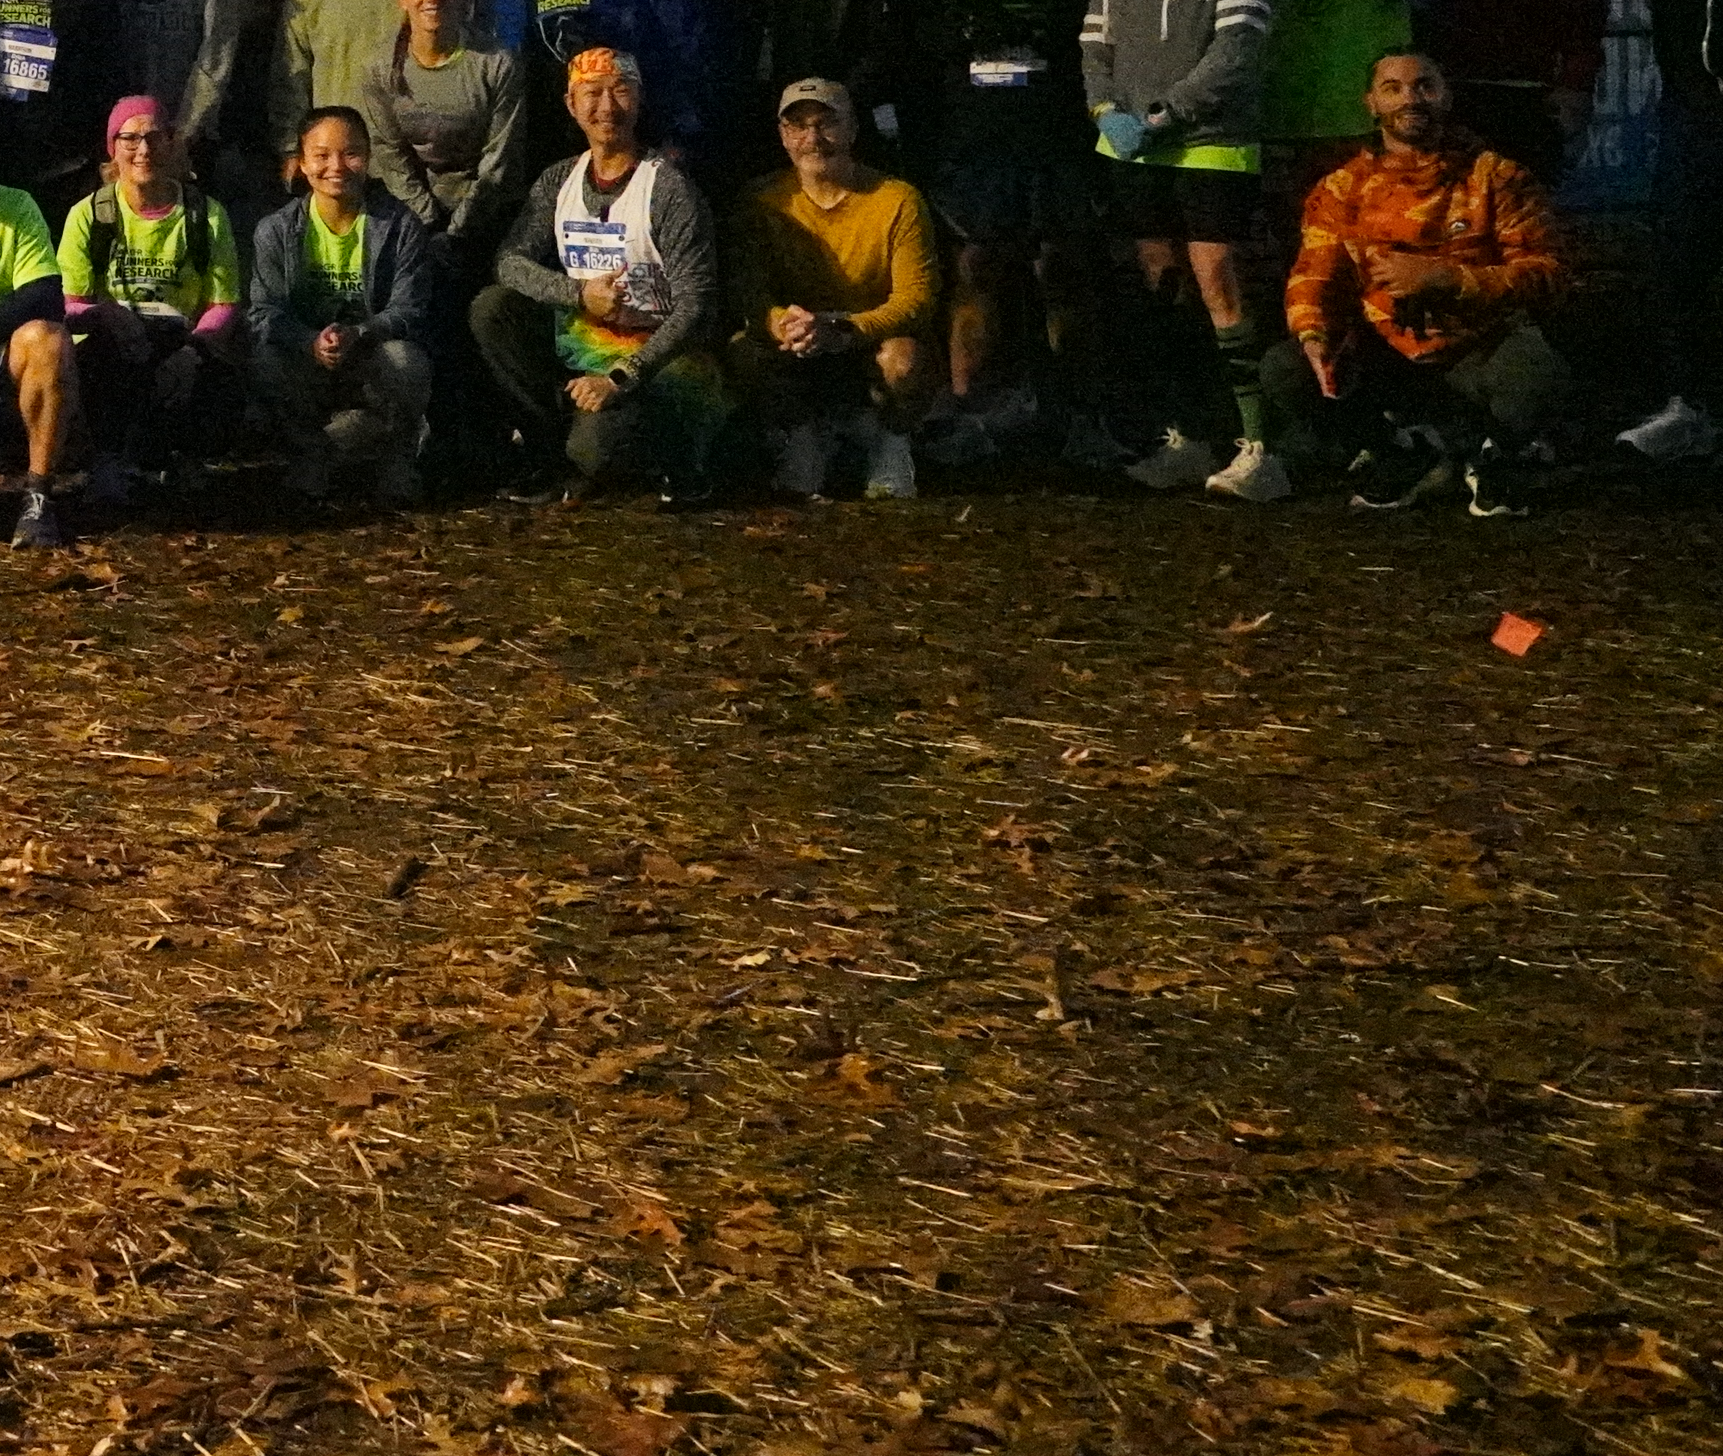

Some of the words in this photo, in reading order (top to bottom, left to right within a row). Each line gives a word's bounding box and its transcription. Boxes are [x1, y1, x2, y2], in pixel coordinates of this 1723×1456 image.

[3, 58, 48, 81] 16865
[569, 251, 579, 267] G
[582, 251, 621, 271] 16226
